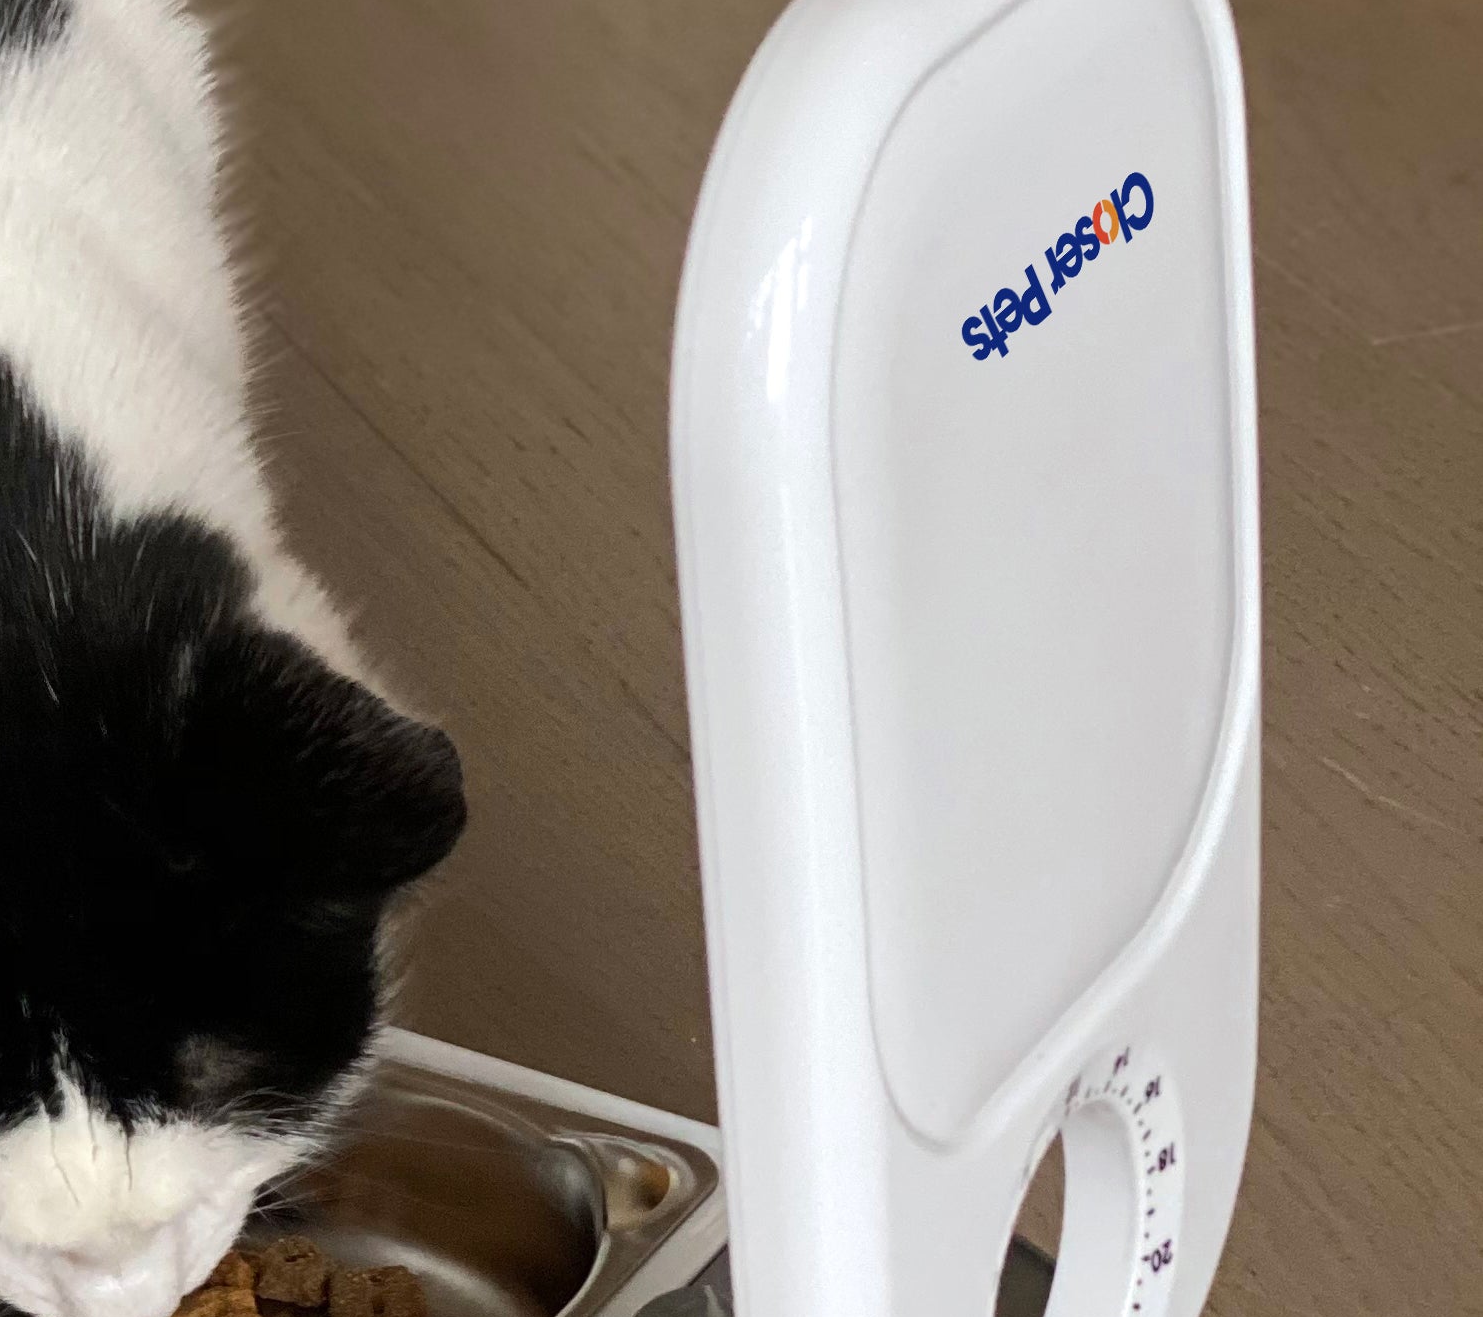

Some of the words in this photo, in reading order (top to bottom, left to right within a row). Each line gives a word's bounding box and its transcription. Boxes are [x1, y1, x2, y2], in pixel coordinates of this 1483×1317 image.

[1043, 172, 1154, 295] Closer
[961, 263, 1052, 361] Pets
[1159, 1141, 1176, 1173] 18
[1151, 1239, 1173, 1272] 20
